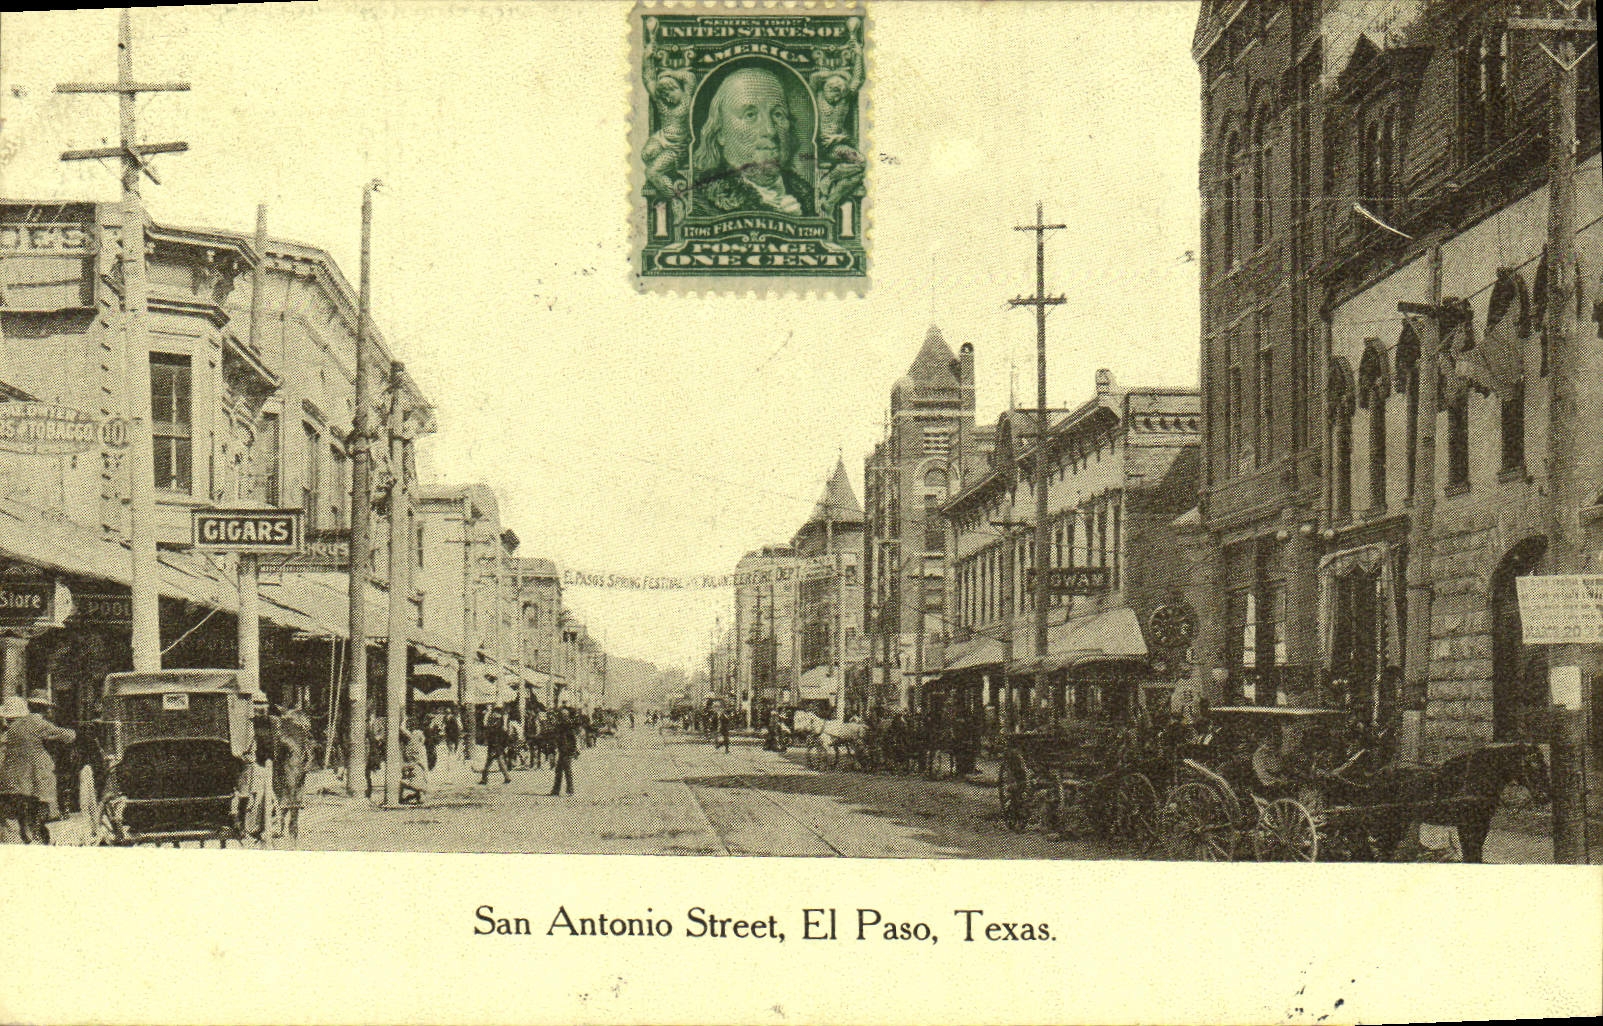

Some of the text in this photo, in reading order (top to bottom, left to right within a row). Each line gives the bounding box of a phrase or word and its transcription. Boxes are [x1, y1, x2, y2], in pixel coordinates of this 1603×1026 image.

[661, 26, 846, 38] UNITED STATES OF
[699, 43, 809, 63] AMERICA
[655, 201, 669, 237] 1
[713, 218, 796, 236] FRANKLIN
[839, 201, 854, 237] 1
[693, 243, 816, 253] POSTAGE
[665, 254, 845, 267] ONE CENT
[203, 519, 289, 541] CIGARS
[643, 574, 683, 590] FESTIVAL
